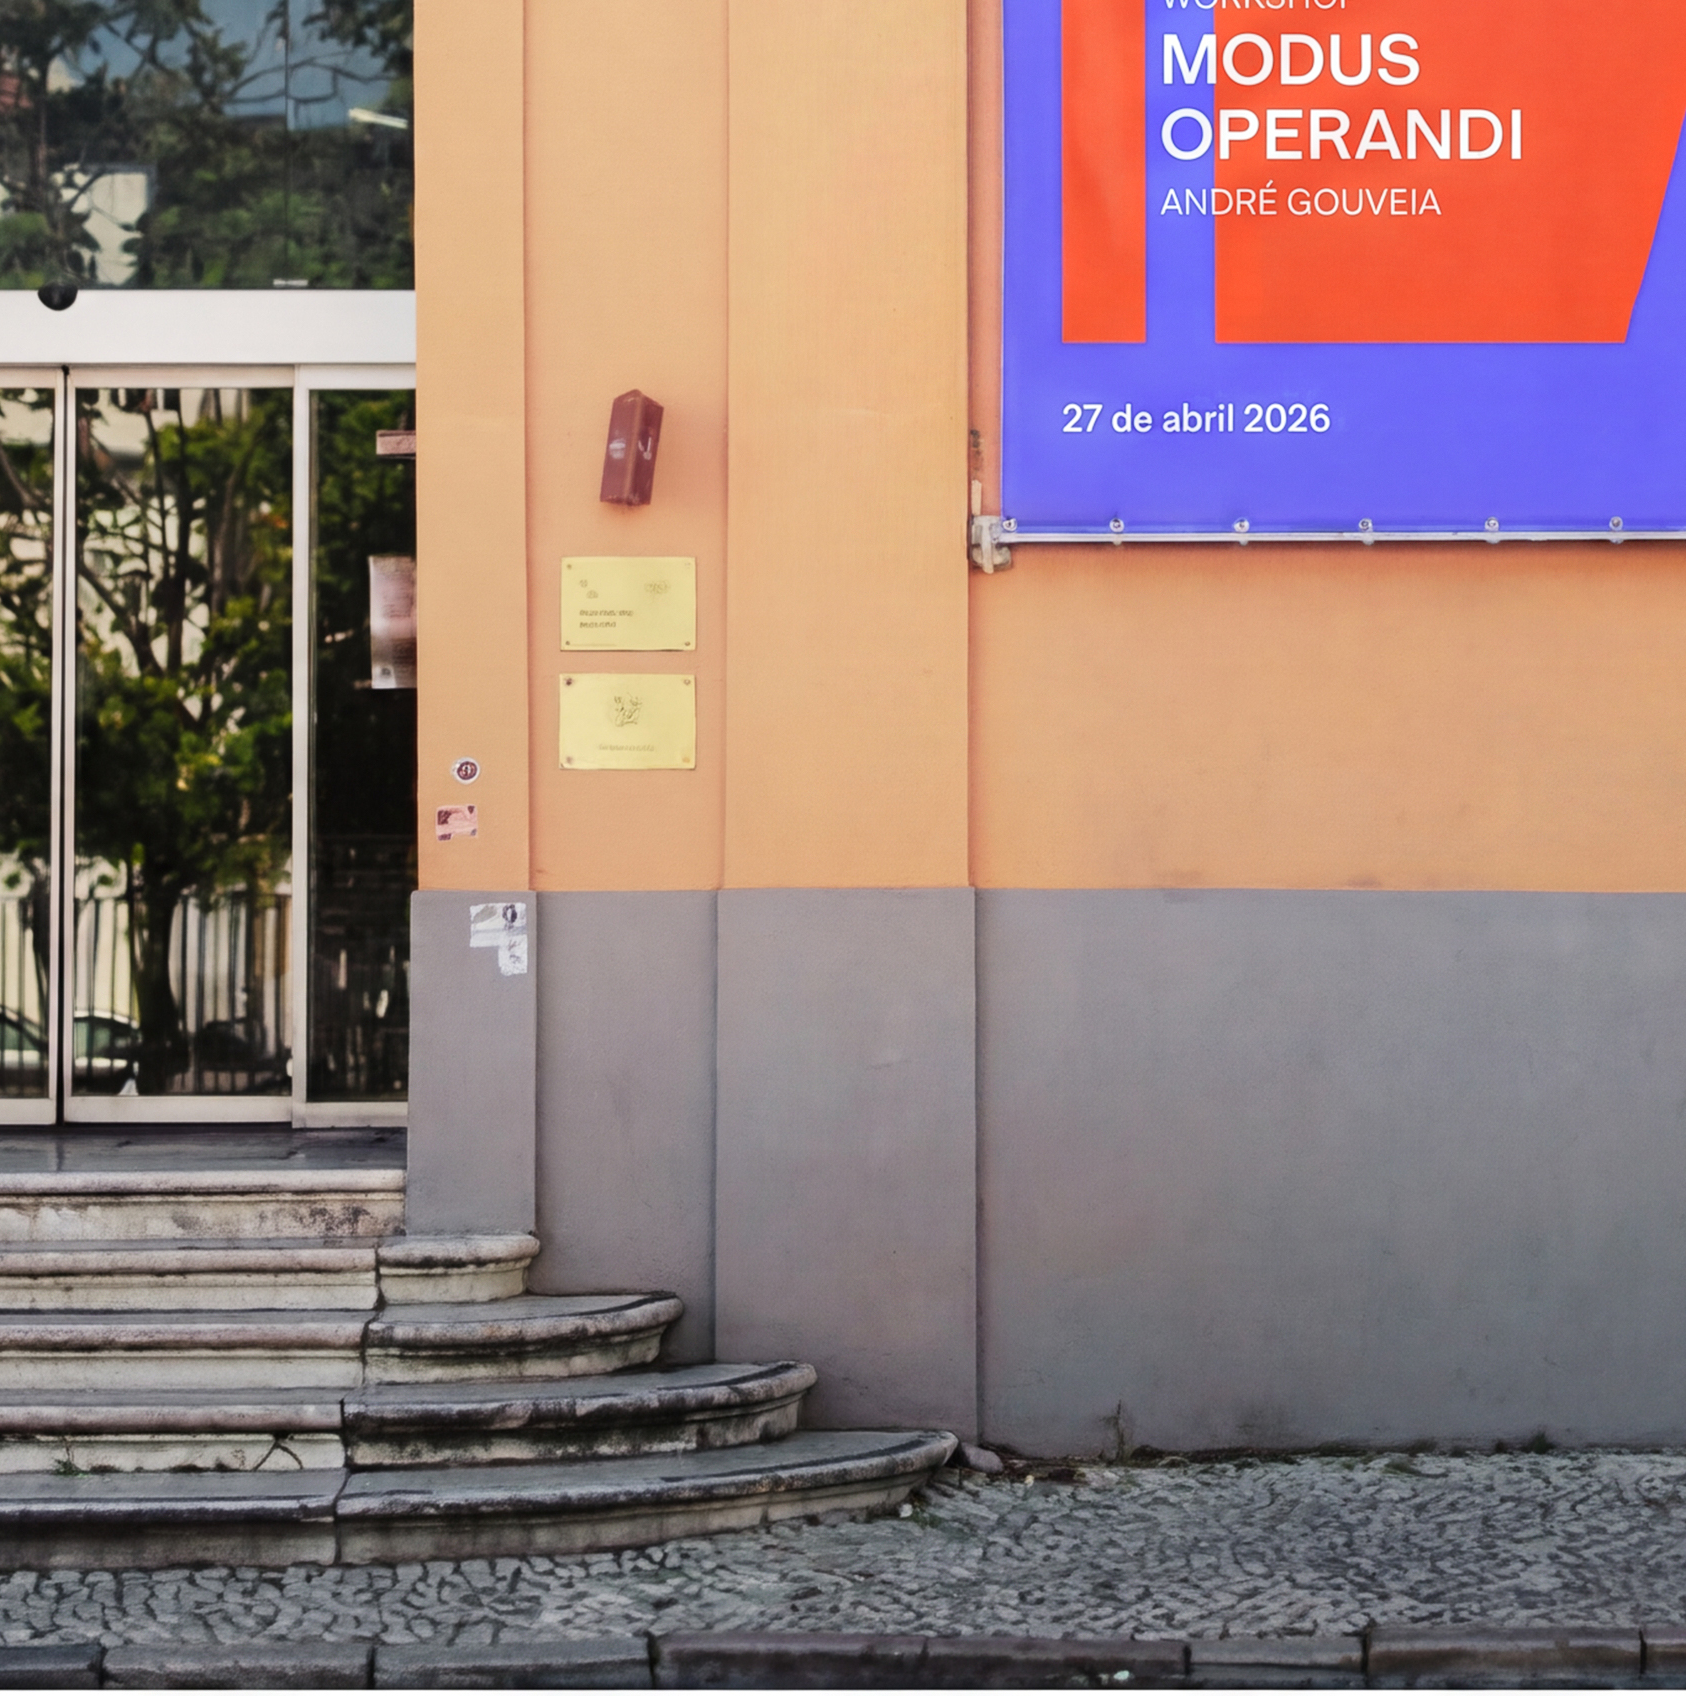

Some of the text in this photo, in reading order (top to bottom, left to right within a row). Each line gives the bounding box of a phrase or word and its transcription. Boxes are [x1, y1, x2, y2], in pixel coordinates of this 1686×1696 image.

[1163, 33, 1420, 86] MODUS
[1161, 107, 1522, 161] OPERANDI
[1160, 180, 1442, 216] ANDRÉ GOUVEIA
[1062, 402, 1331, 433] 27 de abril 2026
